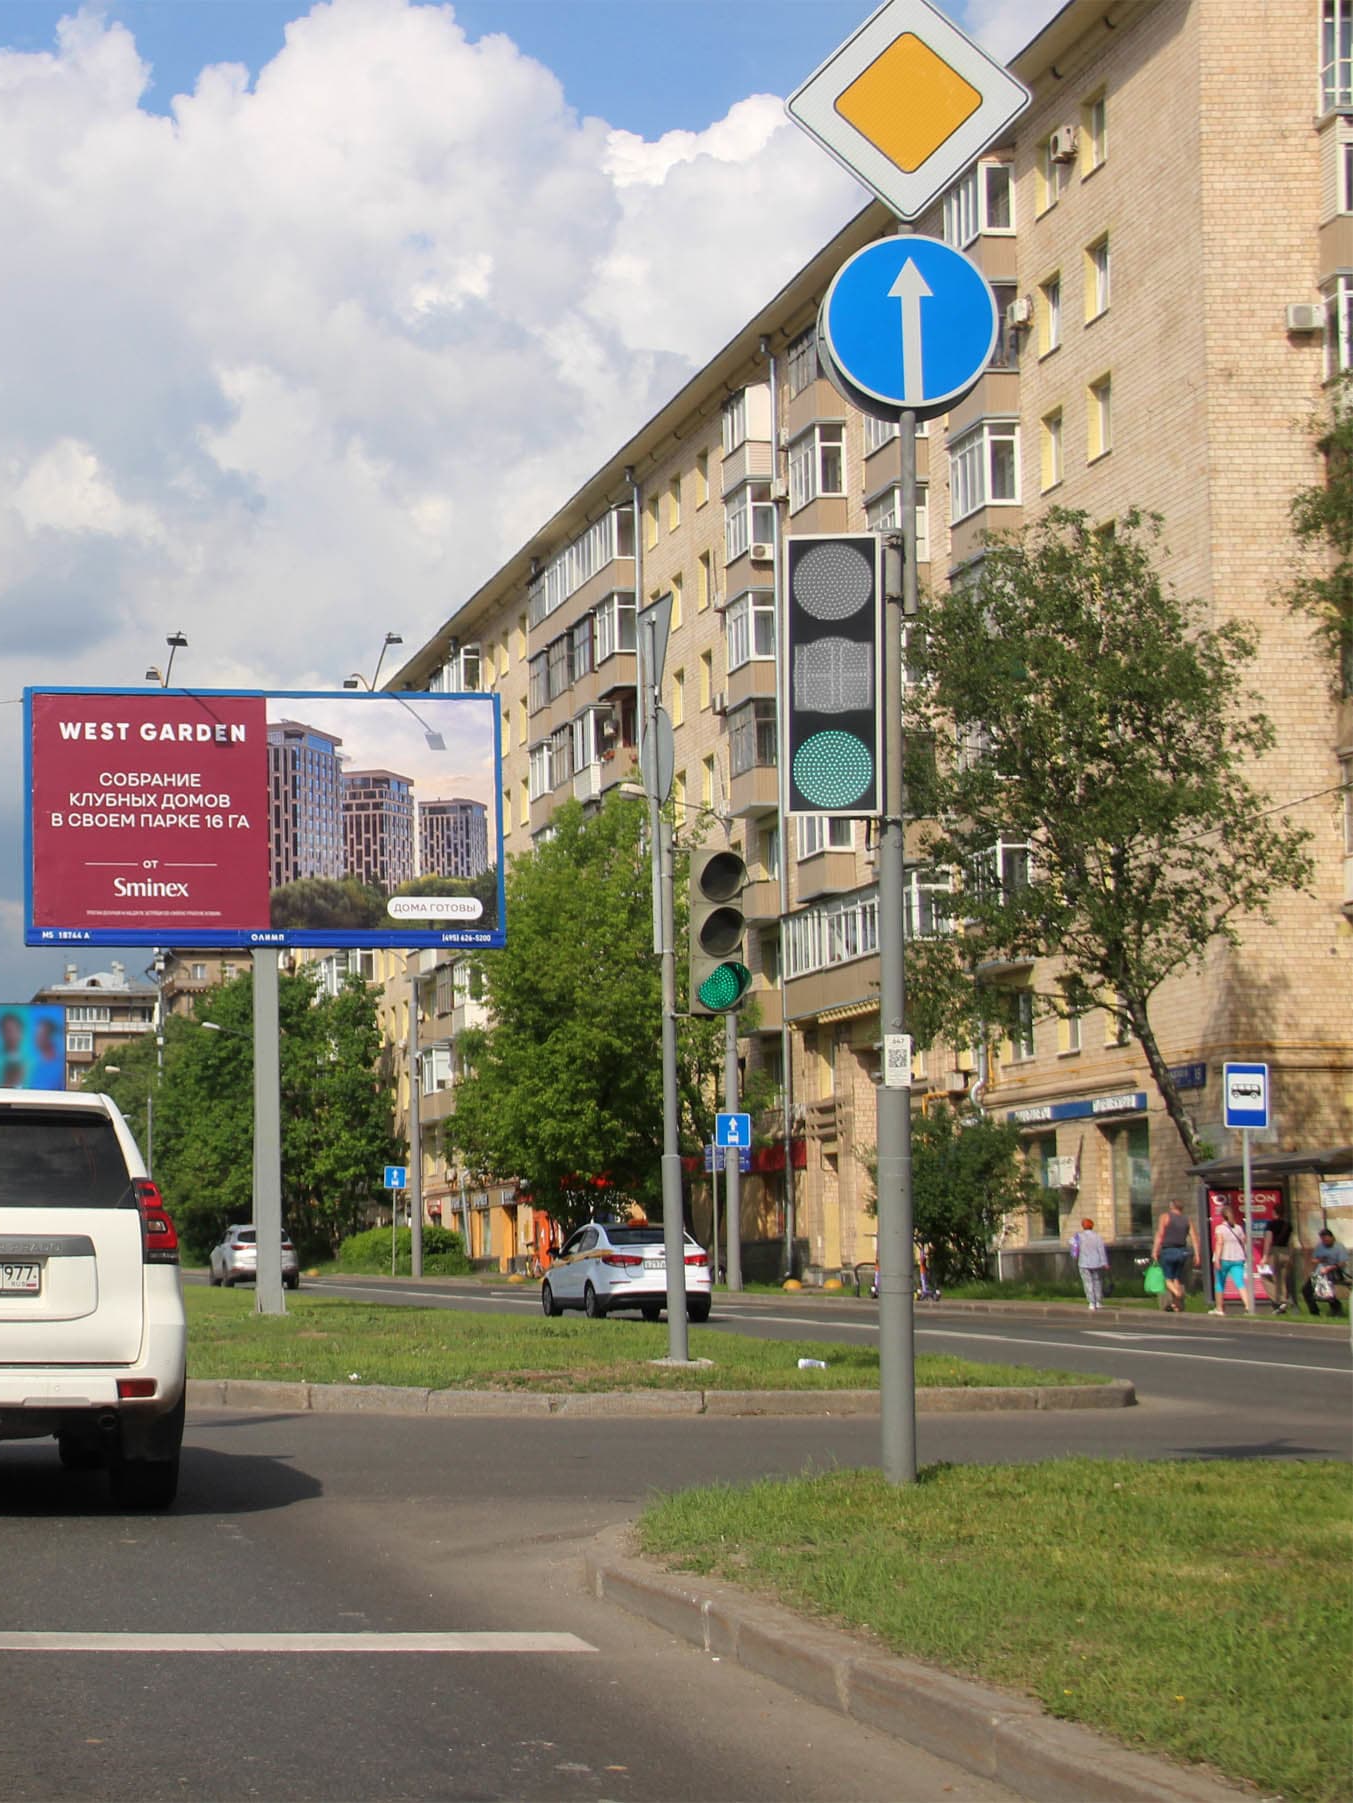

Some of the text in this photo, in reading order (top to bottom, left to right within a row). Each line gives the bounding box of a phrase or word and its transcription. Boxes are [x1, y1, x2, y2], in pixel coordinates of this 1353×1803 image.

[59, 721, 246, 742] WEST GARDEN
[99, 772, 201, 787] СОБРАНИЕ
[69, 793, 231, 810] КЛУБНЫХ ДОМОВ
[51, 813, 250, 828] В СВОЕМ ПАРКЕ 16 ГА
[113, 877, 190, 897] Sminex
[394, 904, 476, 914] ДОМА ГОТОВЫ
[250, 933, 285, 942] ОЛИМП
[4, 1266, 34, 1281] 977
